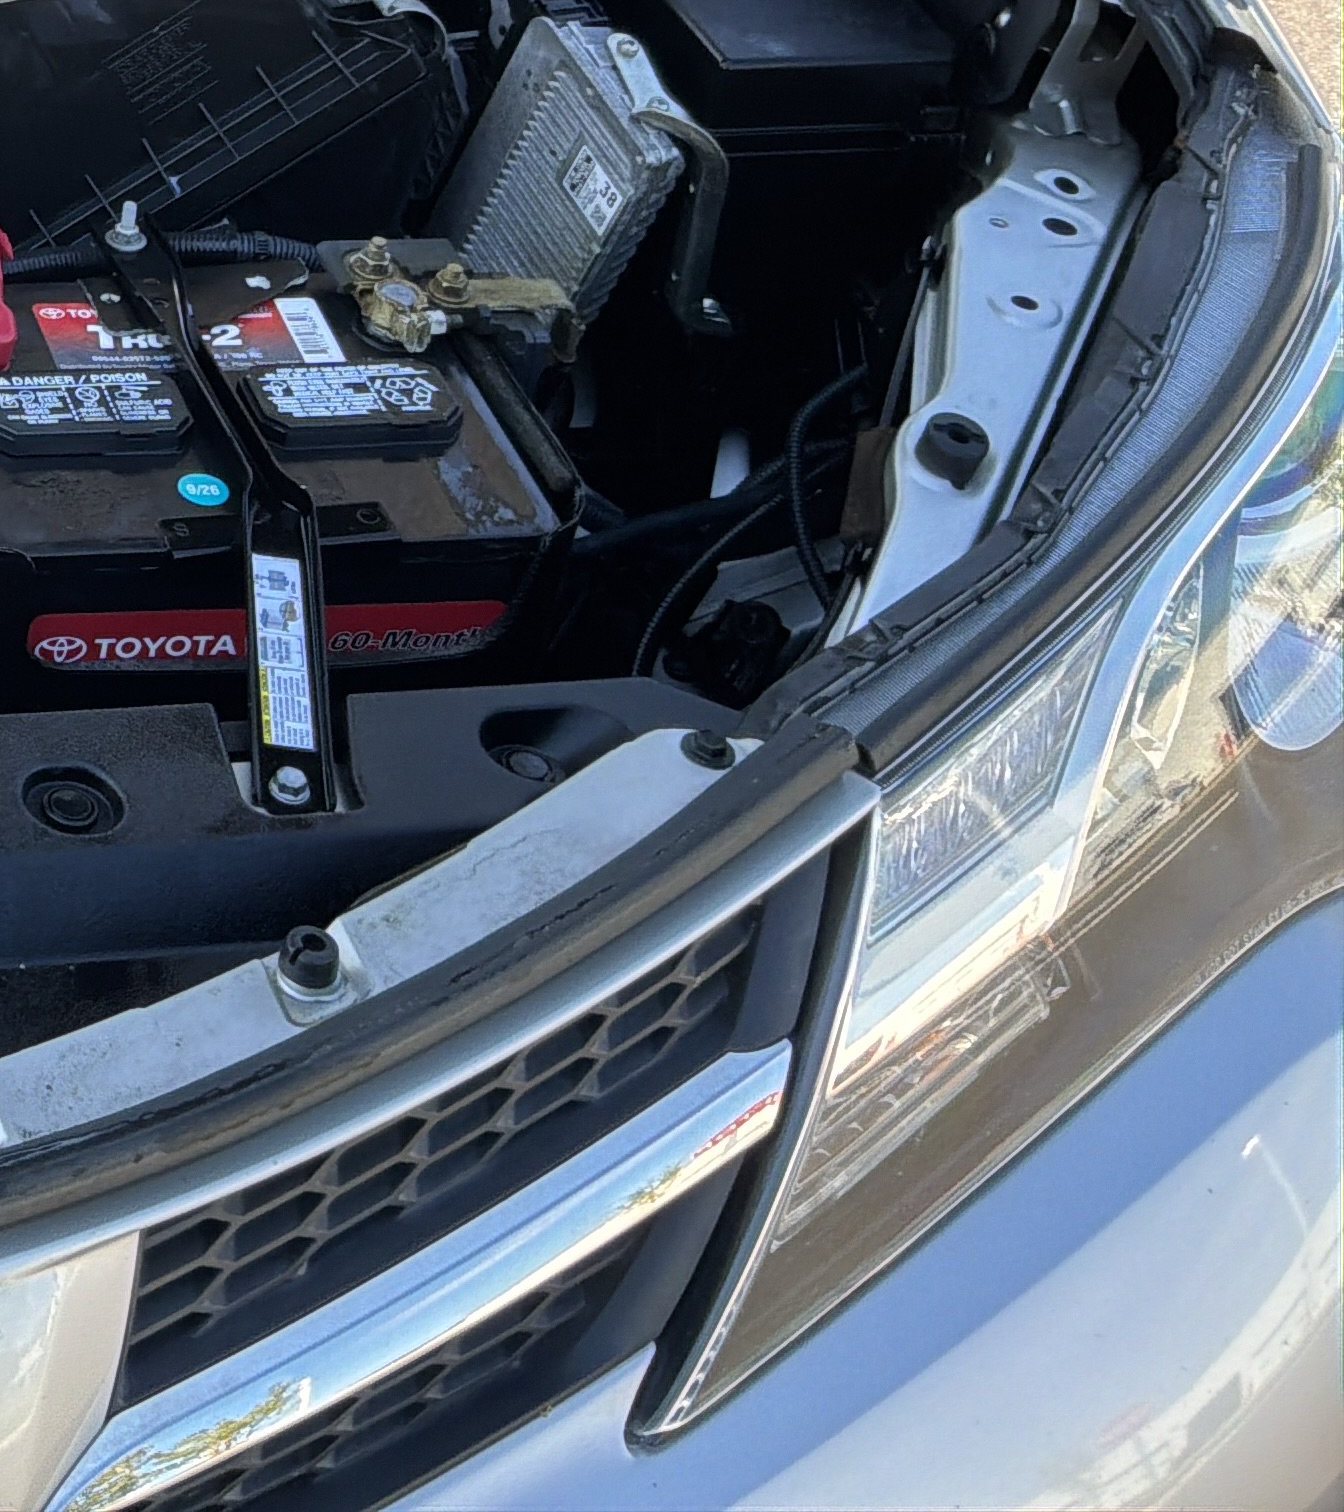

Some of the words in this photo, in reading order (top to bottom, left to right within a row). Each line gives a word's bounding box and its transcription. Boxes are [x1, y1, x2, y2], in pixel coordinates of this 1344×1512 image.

[599, 182, 617, 209] 38
[12, 375, 75, 386] DANGER
[90, 372, 148, 383] POISON
[94, 635, 237, 659] TOYOTA
